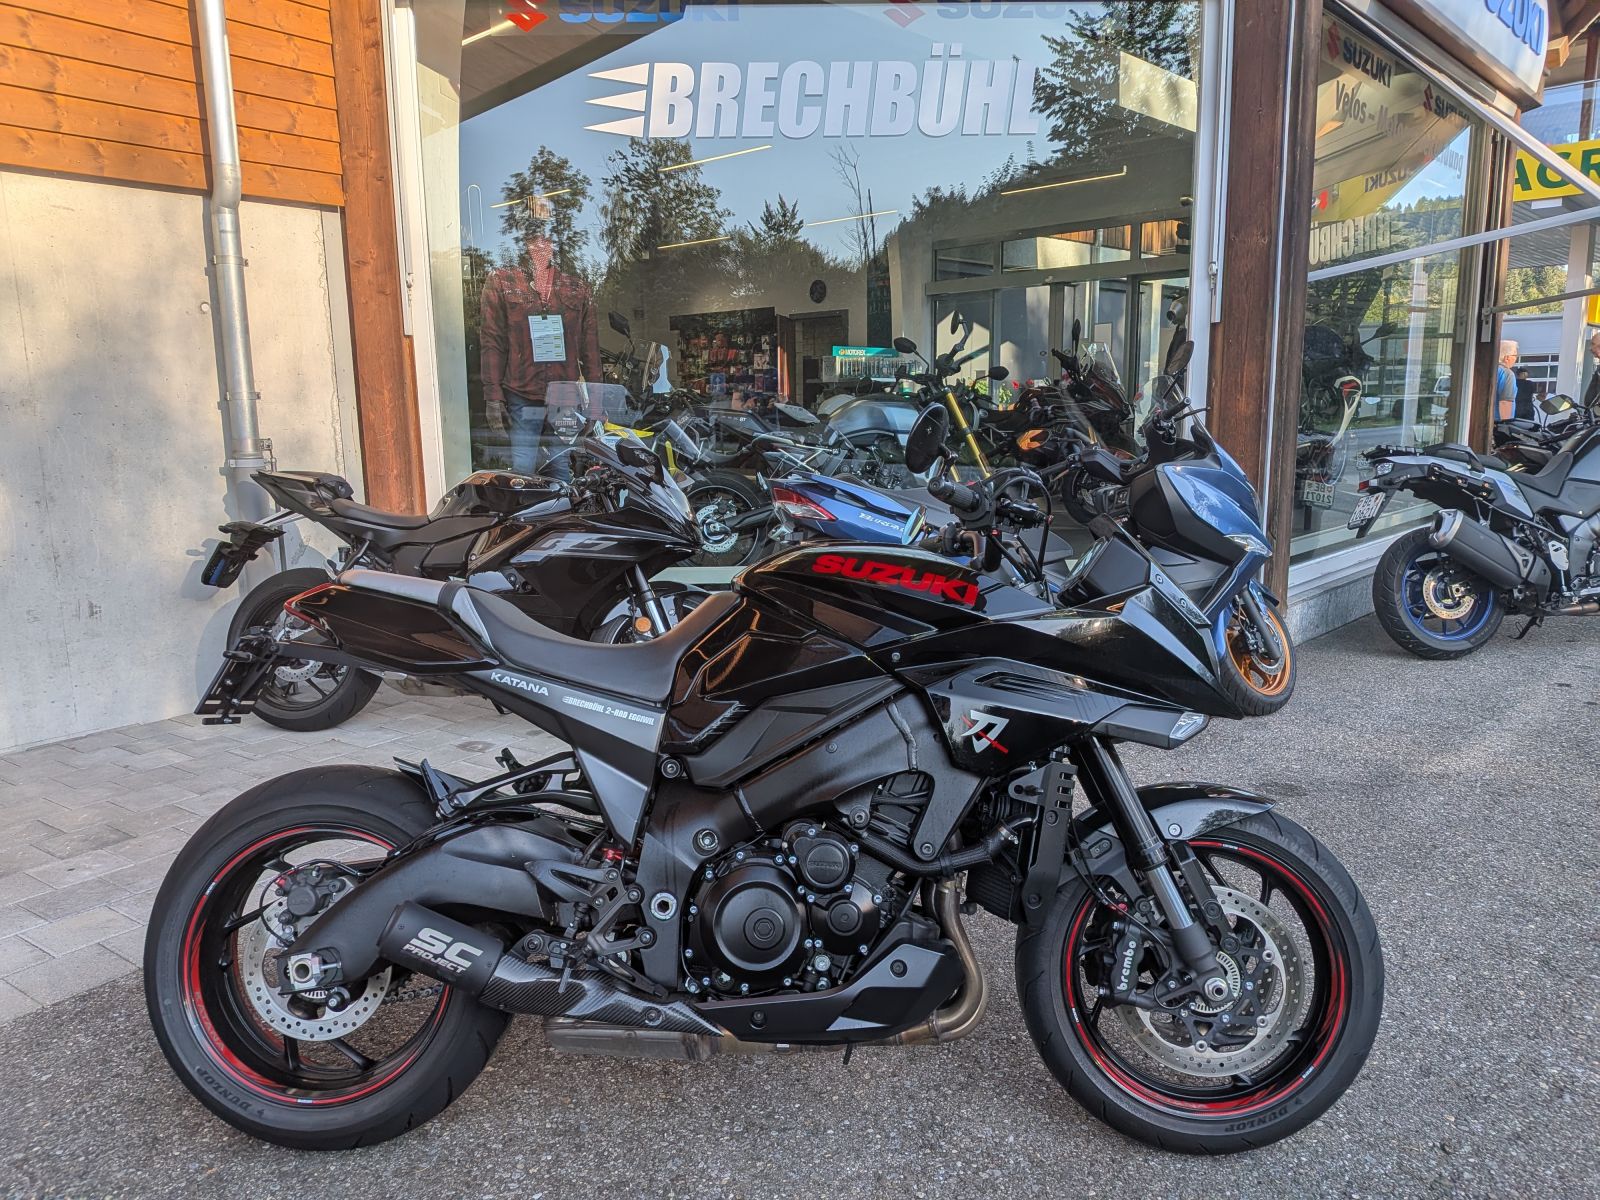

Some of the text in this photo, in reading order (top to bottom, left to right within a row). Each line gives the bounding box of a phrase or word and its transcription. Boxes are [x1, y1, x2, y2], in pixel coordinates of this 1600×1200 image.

[1343, 36, 1392, 88] SUZUKI
[648, 42, 1040, 139] BRECHBÜHL
[1336, 79, 1368, 124] Velos
[812, 554, 979, 606] SUZUKI
[490, 671, 549, 697] KATANA
[604, 706, 629, 719] 2-RAD
[402, 943, 467, 973] PROJECT
[409, 927, 484, 968] SC
[1116, 940, 1137, 991] brembo
[195, 1065, 252, 1111] DUNLOP
[1224, 1105, 1289, 1133] DUNLOP
